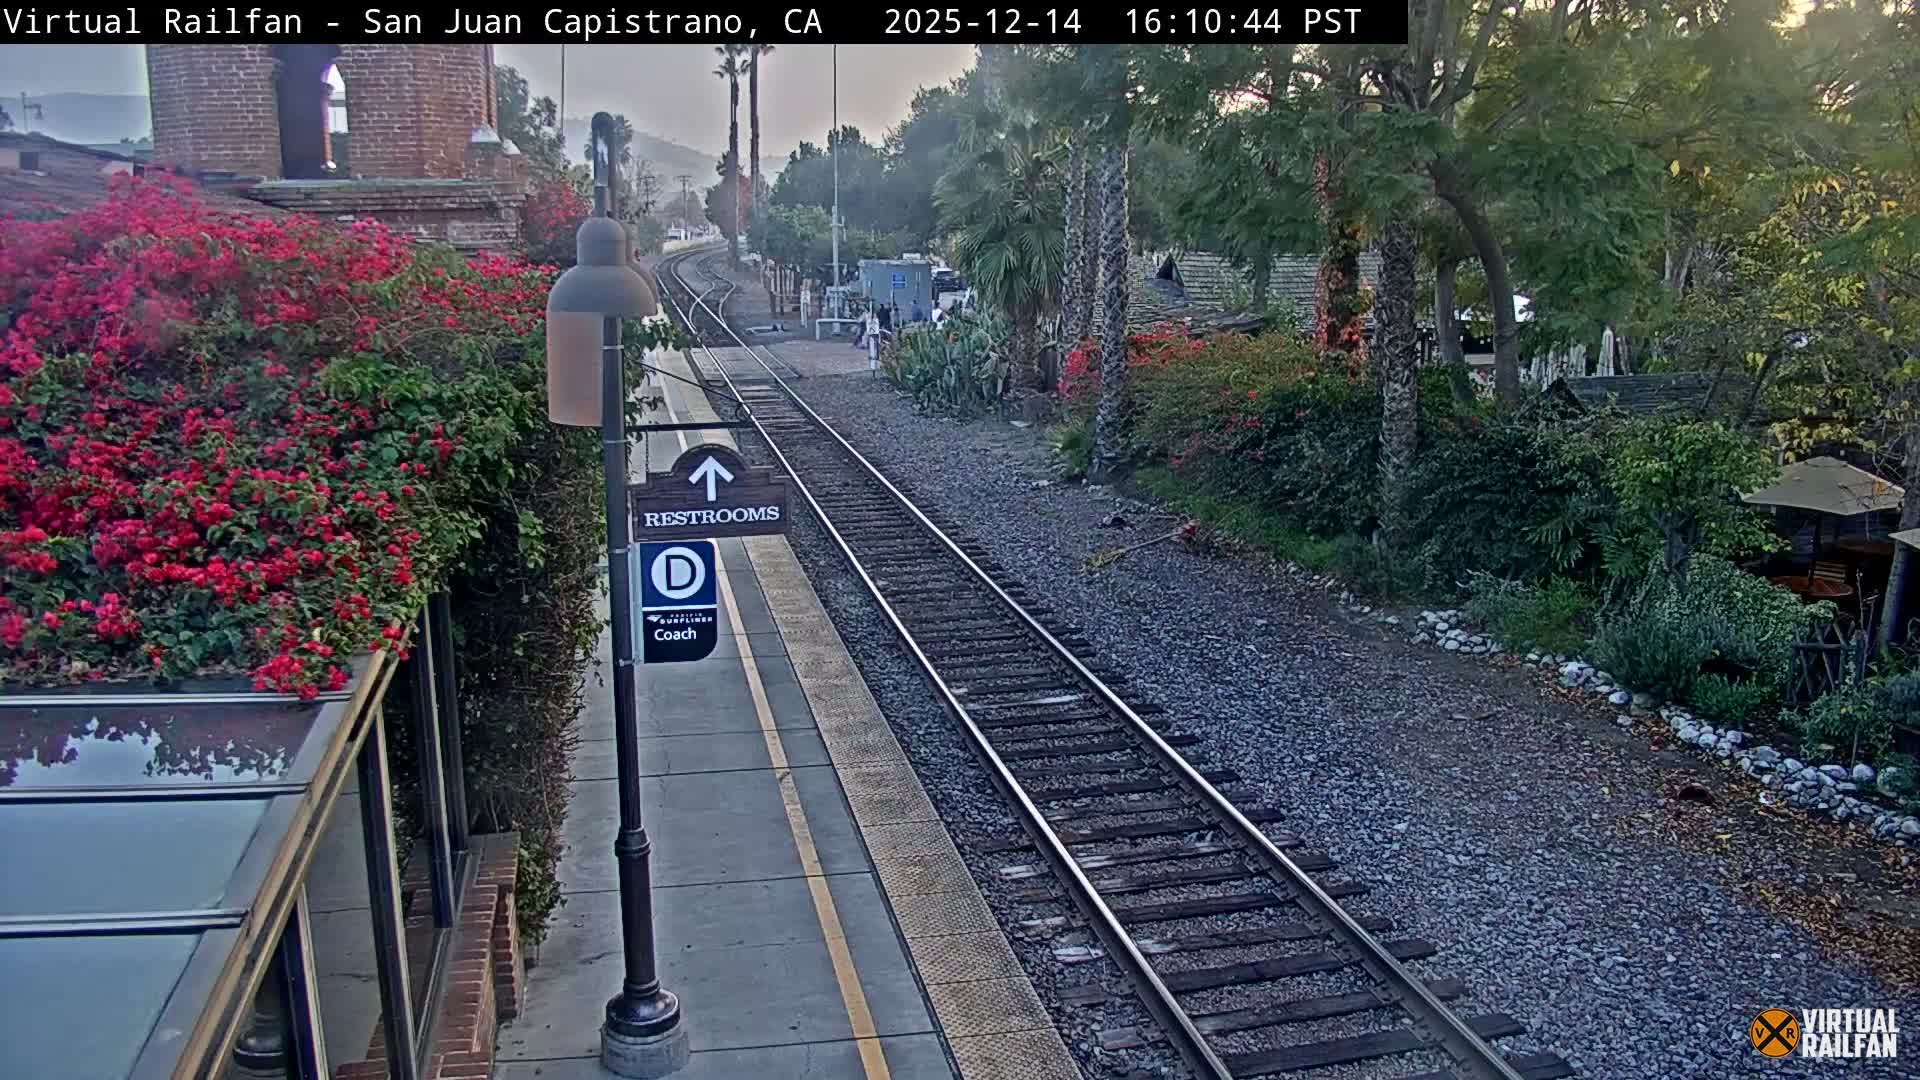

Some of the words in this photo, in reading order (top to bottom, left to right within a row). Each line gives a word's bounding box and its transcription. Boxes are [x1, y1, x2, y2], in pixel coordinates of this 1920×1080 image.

[644, 506, 780, 527] RESTROOMS
[665, 554, 697, 591] D
[654, 627, 697, 641] Coach
